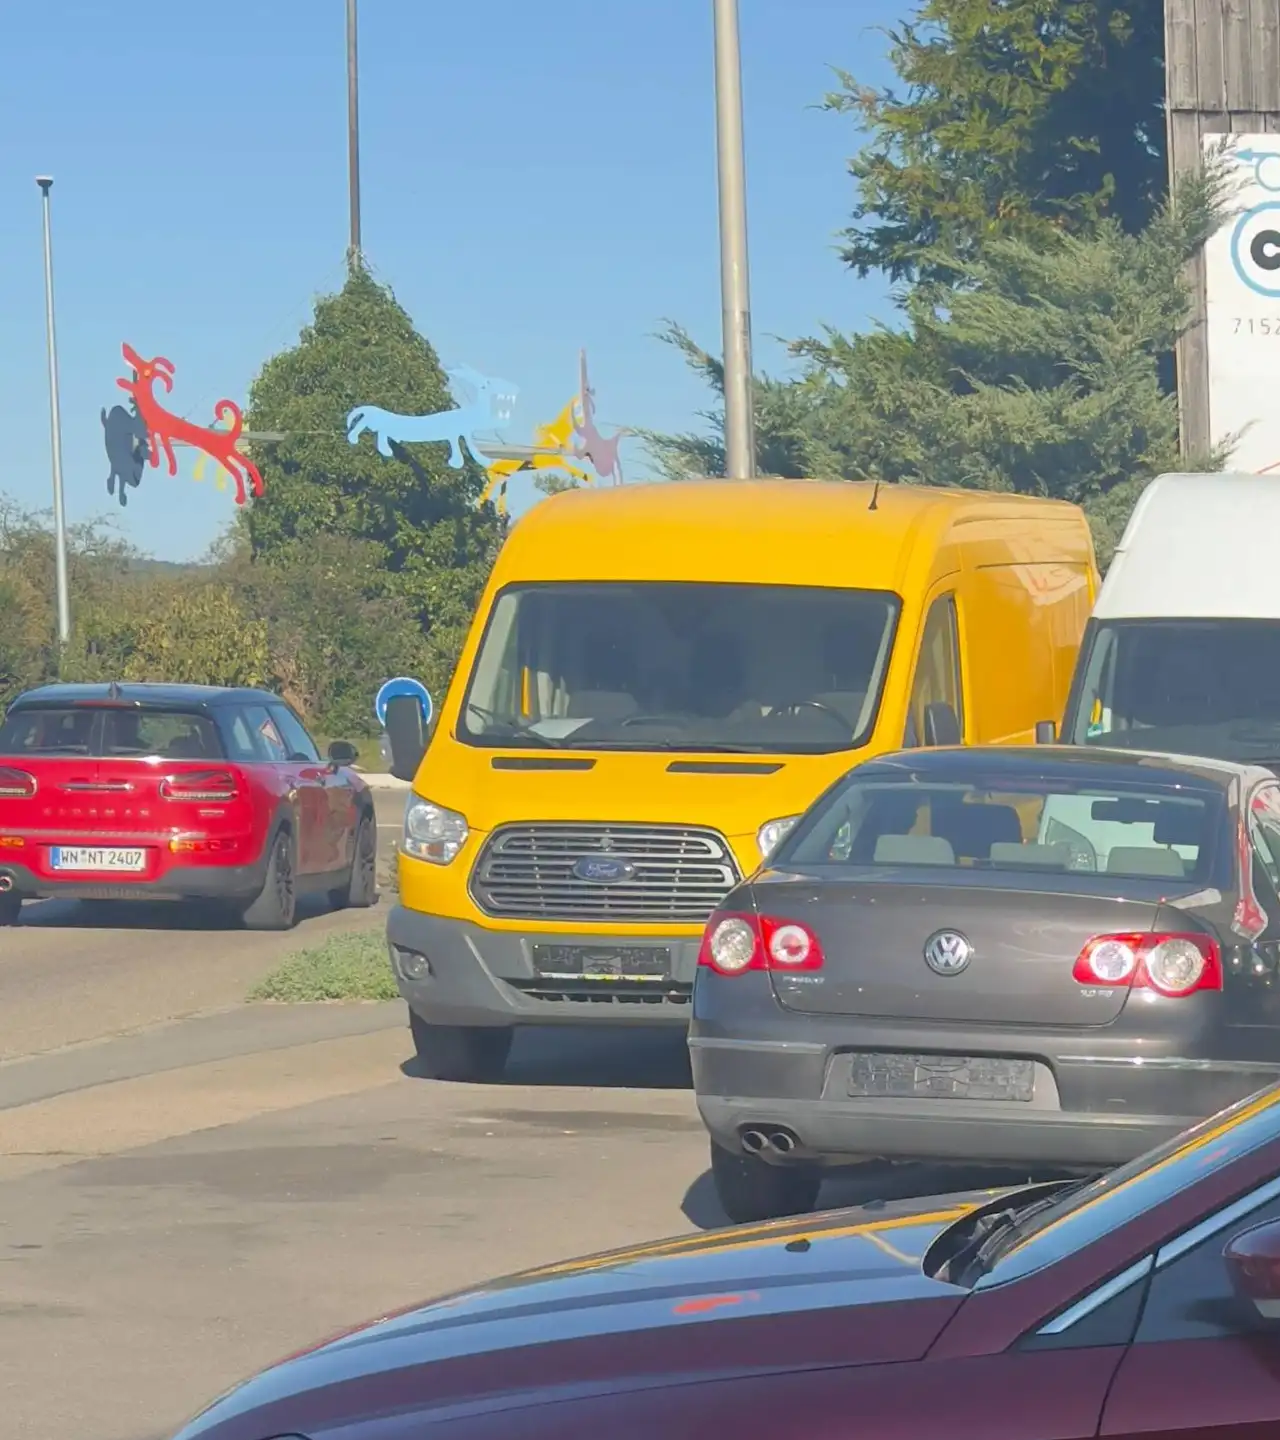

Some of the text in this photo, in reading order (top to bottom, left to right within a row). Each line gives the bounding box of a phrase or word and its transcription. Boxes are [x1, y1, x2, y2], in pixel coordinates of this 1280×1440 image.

[61, 848, 142, 866] WN NT 2407
